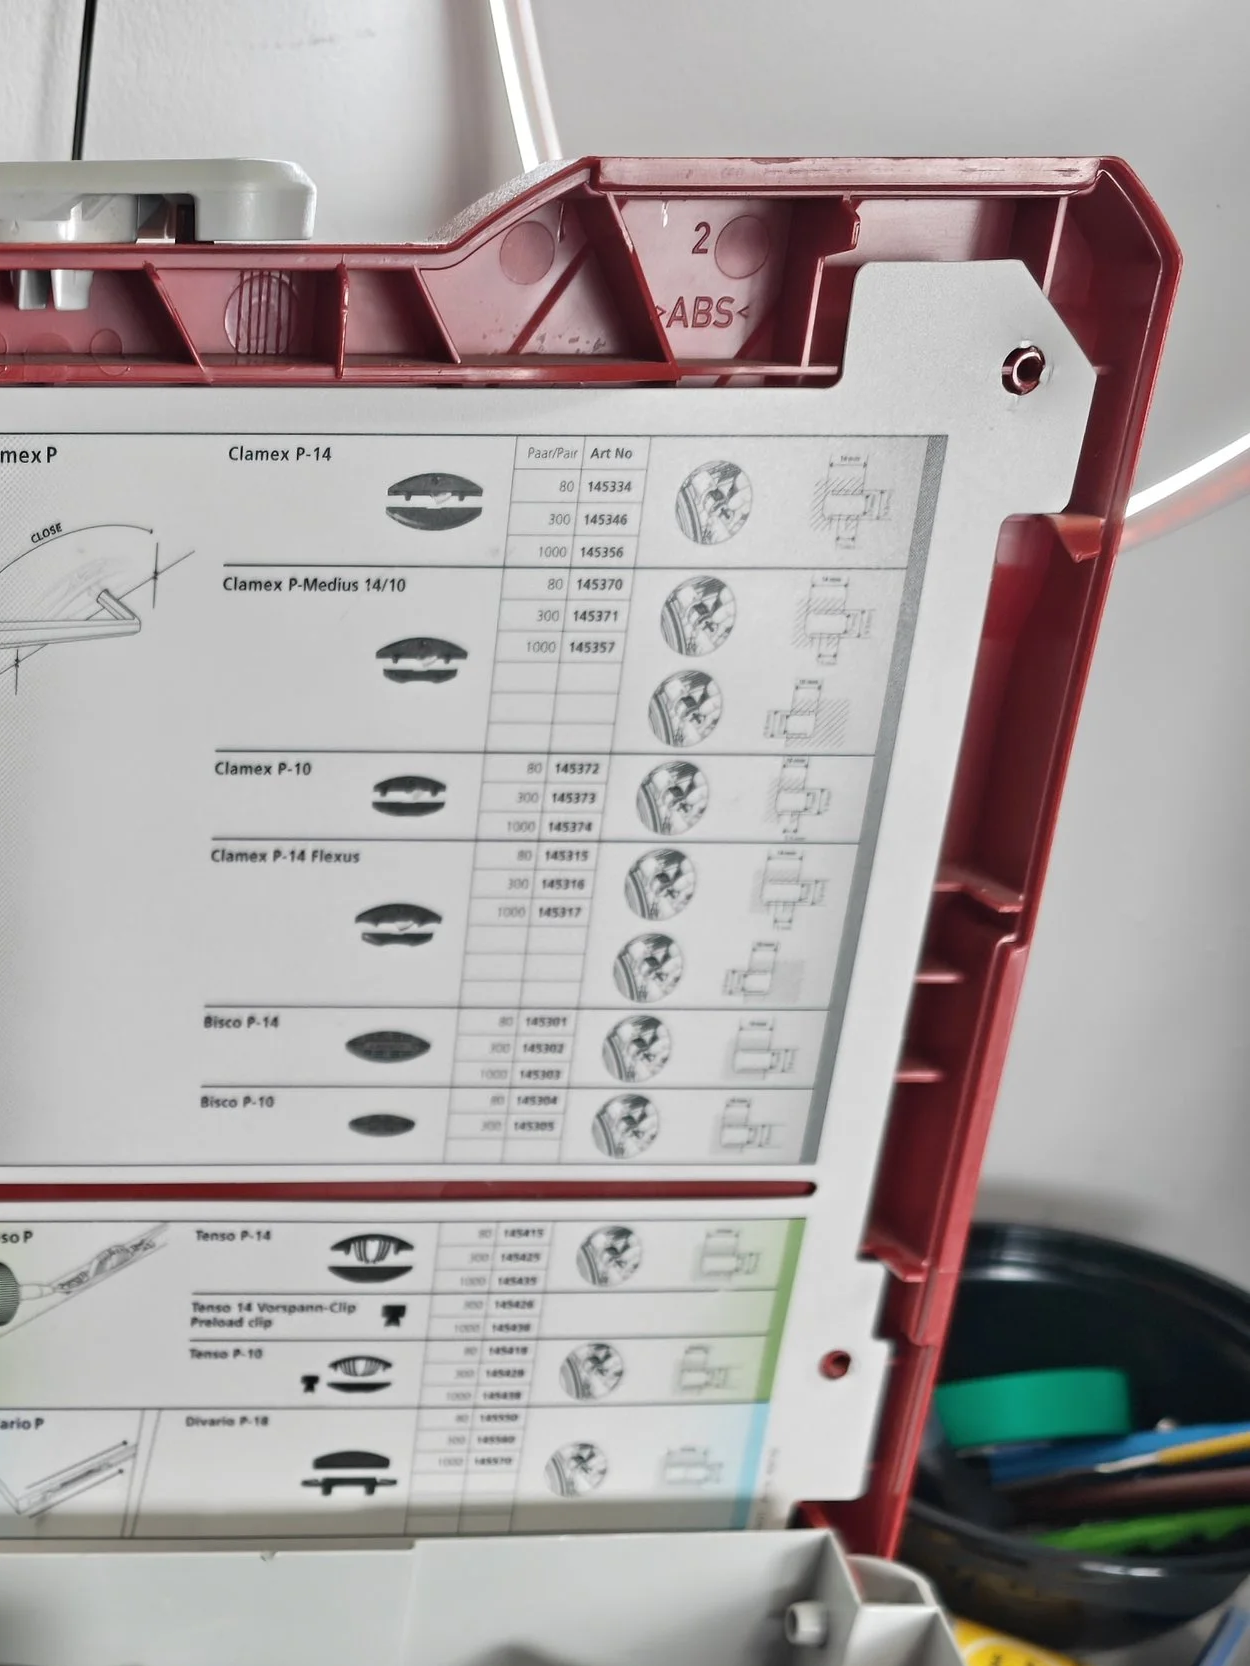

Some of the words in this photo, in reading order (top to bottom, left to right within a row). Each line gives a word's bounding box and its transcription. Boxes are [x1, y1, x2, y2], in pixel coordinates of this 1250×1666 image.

[692, 221, 712, 254] 2
[46, 446, 58, 463] P
[227, 446, 291, 462] Clamex
[296, 446, 332, 462] P-14
[527, 447, 579, 462] Paar/Pair
[590, 447, 609, 460] Art
[613, 447, 633, 460] No
[558, 480, 575, 493] 80
[587, 480, 632, 493] 145334
[548, 513, 571, 526] 300
[584, 513, 628, 526] 145346
[30, 522, 64, 544] CLOSE
[538, 546, 567, 559] 1000
[580, 545, 624, 559] 145356
[222, 577, 283, 593] Clamex
[288, 577, 359, 592] P-Medius
[364, 577, 406, 594] 14/10
[547, 578, 564, 591] 80
[576, 578, 624, 591] 145370
[537, 610, 560, 622] 300
[572, 610, 619, 622] 145371
[526, 641, 557, 654] 1000
[569, 641, 615, 654] 145357
[214, 762, 272, 776] Clamex
[277, 762, 312, 776] P-10
[526, 763, 542, 775] 80
[554, 763, 600, 775] 145372
[516, 792, 539, 804] 300
[551, 792, 596, 804] 145373
[507, 821, 536, 833] 1000
[548, 821, 593, 833] 145374
[210, 849, 267, 864] Clamex
[273, 850, 306, 863] P-14
[311, 849, 361, 864] Flexus
[203, 1015, 242, 1029] Bisco
[246, 1015, 280, 1030] P-14
[200, 1095, 238, 1109] Bisco
[242, 1096, 275, 1109] P-10
[23, 1231, 34, 1244] P
[195, 1230, 236, 1242] Tenso
[240, 1230, 272, 1242] P-14
[191, 1302, 232, 1314] Tenso
[236, 1302, 253, 1314] 14
[257, 1302, 357, 1317] Vorspann-Clip
[190, 1317, 245, 1328] Preload
[248, 1316, 273, 1331] clip
[189, 1348, 229, 1360] Tenso
[34, 1418, 45, 1430] P
[185, 1415, 235, 1427] Divario
